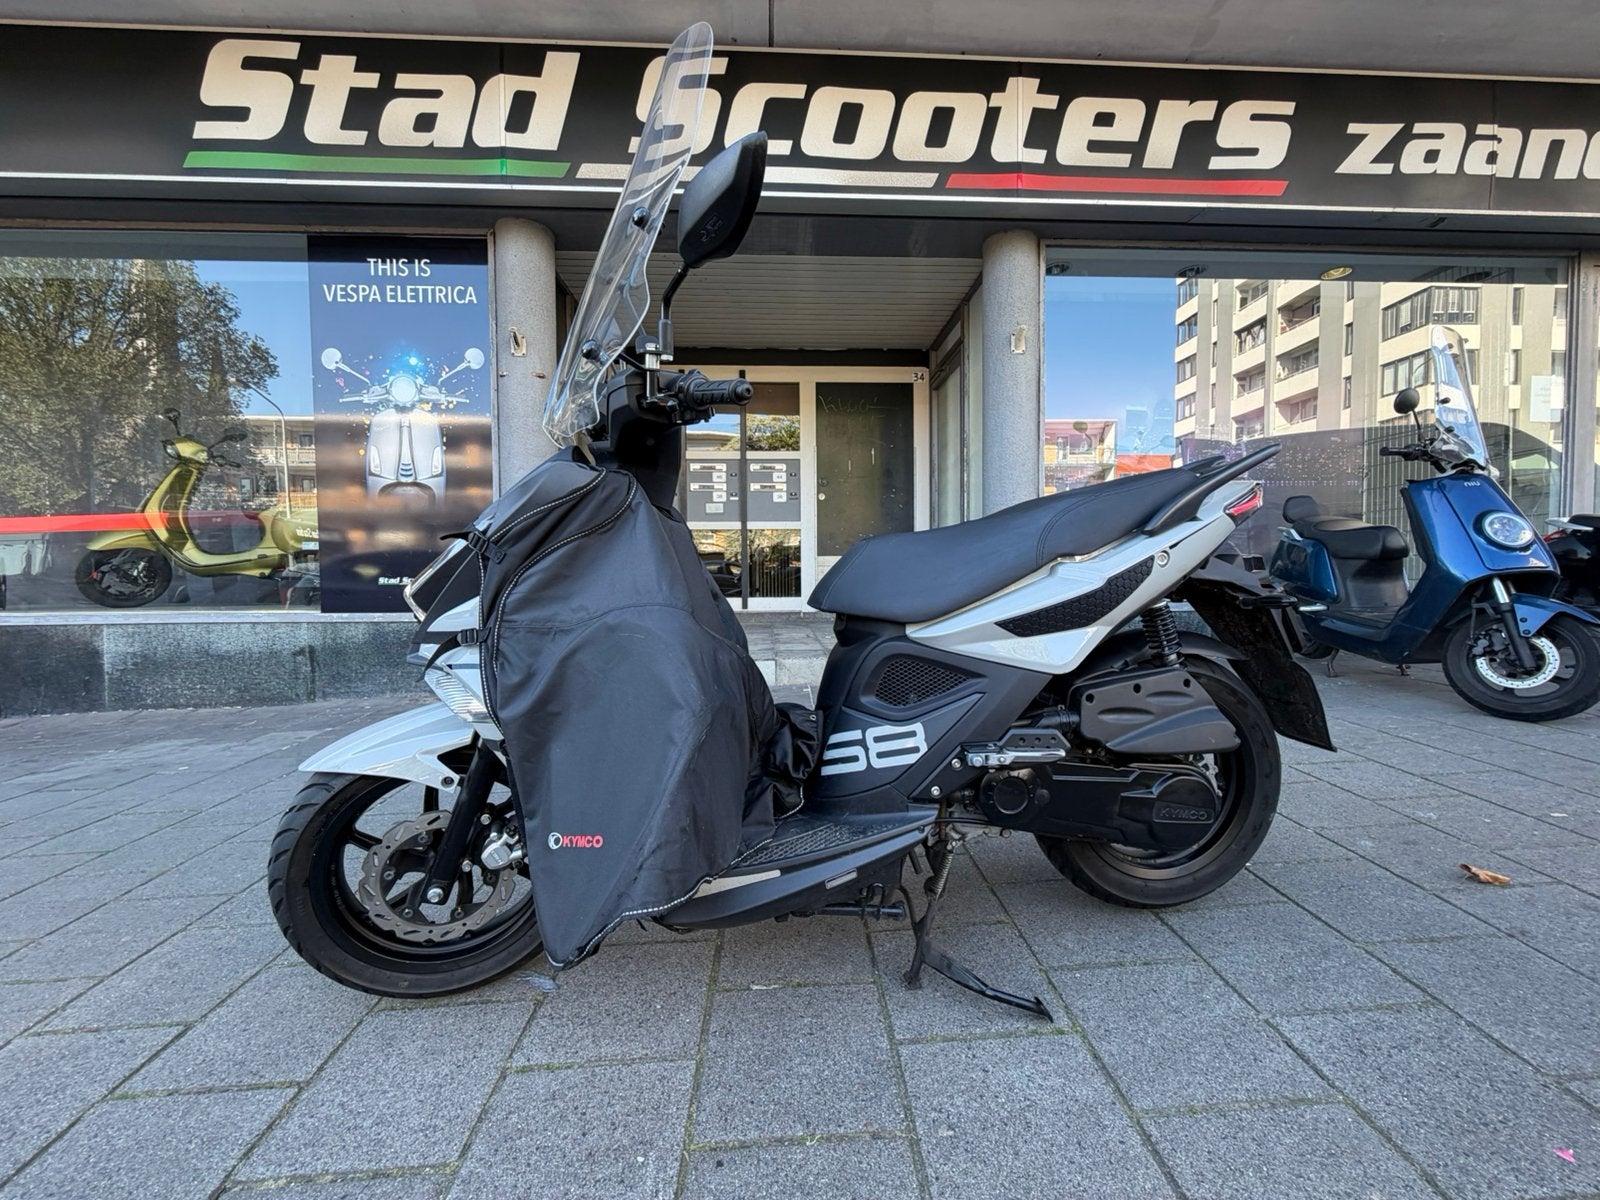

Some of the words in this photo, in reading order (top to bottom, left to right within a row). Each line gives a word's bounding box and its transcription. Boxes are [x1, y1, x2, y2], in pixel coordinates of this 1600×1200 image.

[193, 40, 580, 151] Stad
[628, 55, 1296, 171] Scooters
[366, 258, 409, 276] THIS
[414, 258, 431, 277] IS
[322, 284, 381, 303] VESPA
[386, 285, 478, 304] ELETTRICA
[913, 372, 925, 382] 34
[378, 576, 401, 584] Stad
[1160, 807, 1208, 820] KYMCO
[562, 834, 604, 848] KYMCO
